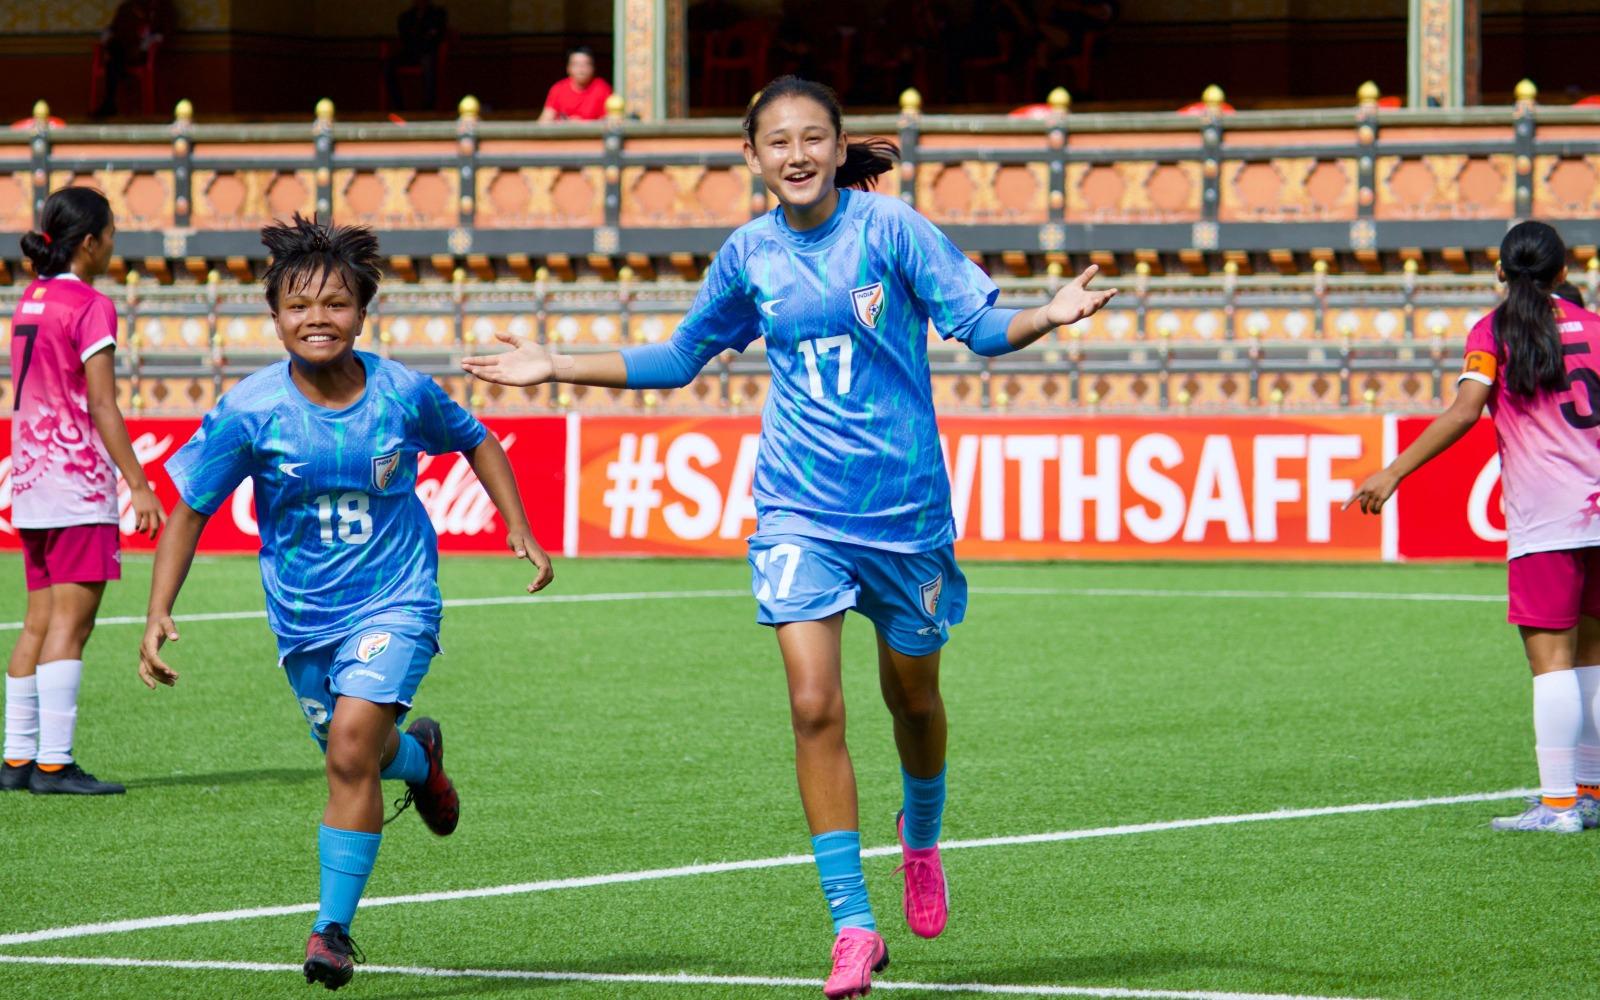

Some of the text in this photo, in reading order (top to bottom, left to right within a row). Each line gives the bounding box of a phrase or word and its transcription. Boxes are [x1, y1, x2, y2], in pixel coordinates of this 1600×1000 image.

[856, 290, 874, 299] INDIA
[14, 324, 38, 411] 7
[797, 334, 853, 399] 17
[1558, 342, 1600, 429] 5
[313, 491, 373, 545] 18
[755, 543, 801, 602] 17
